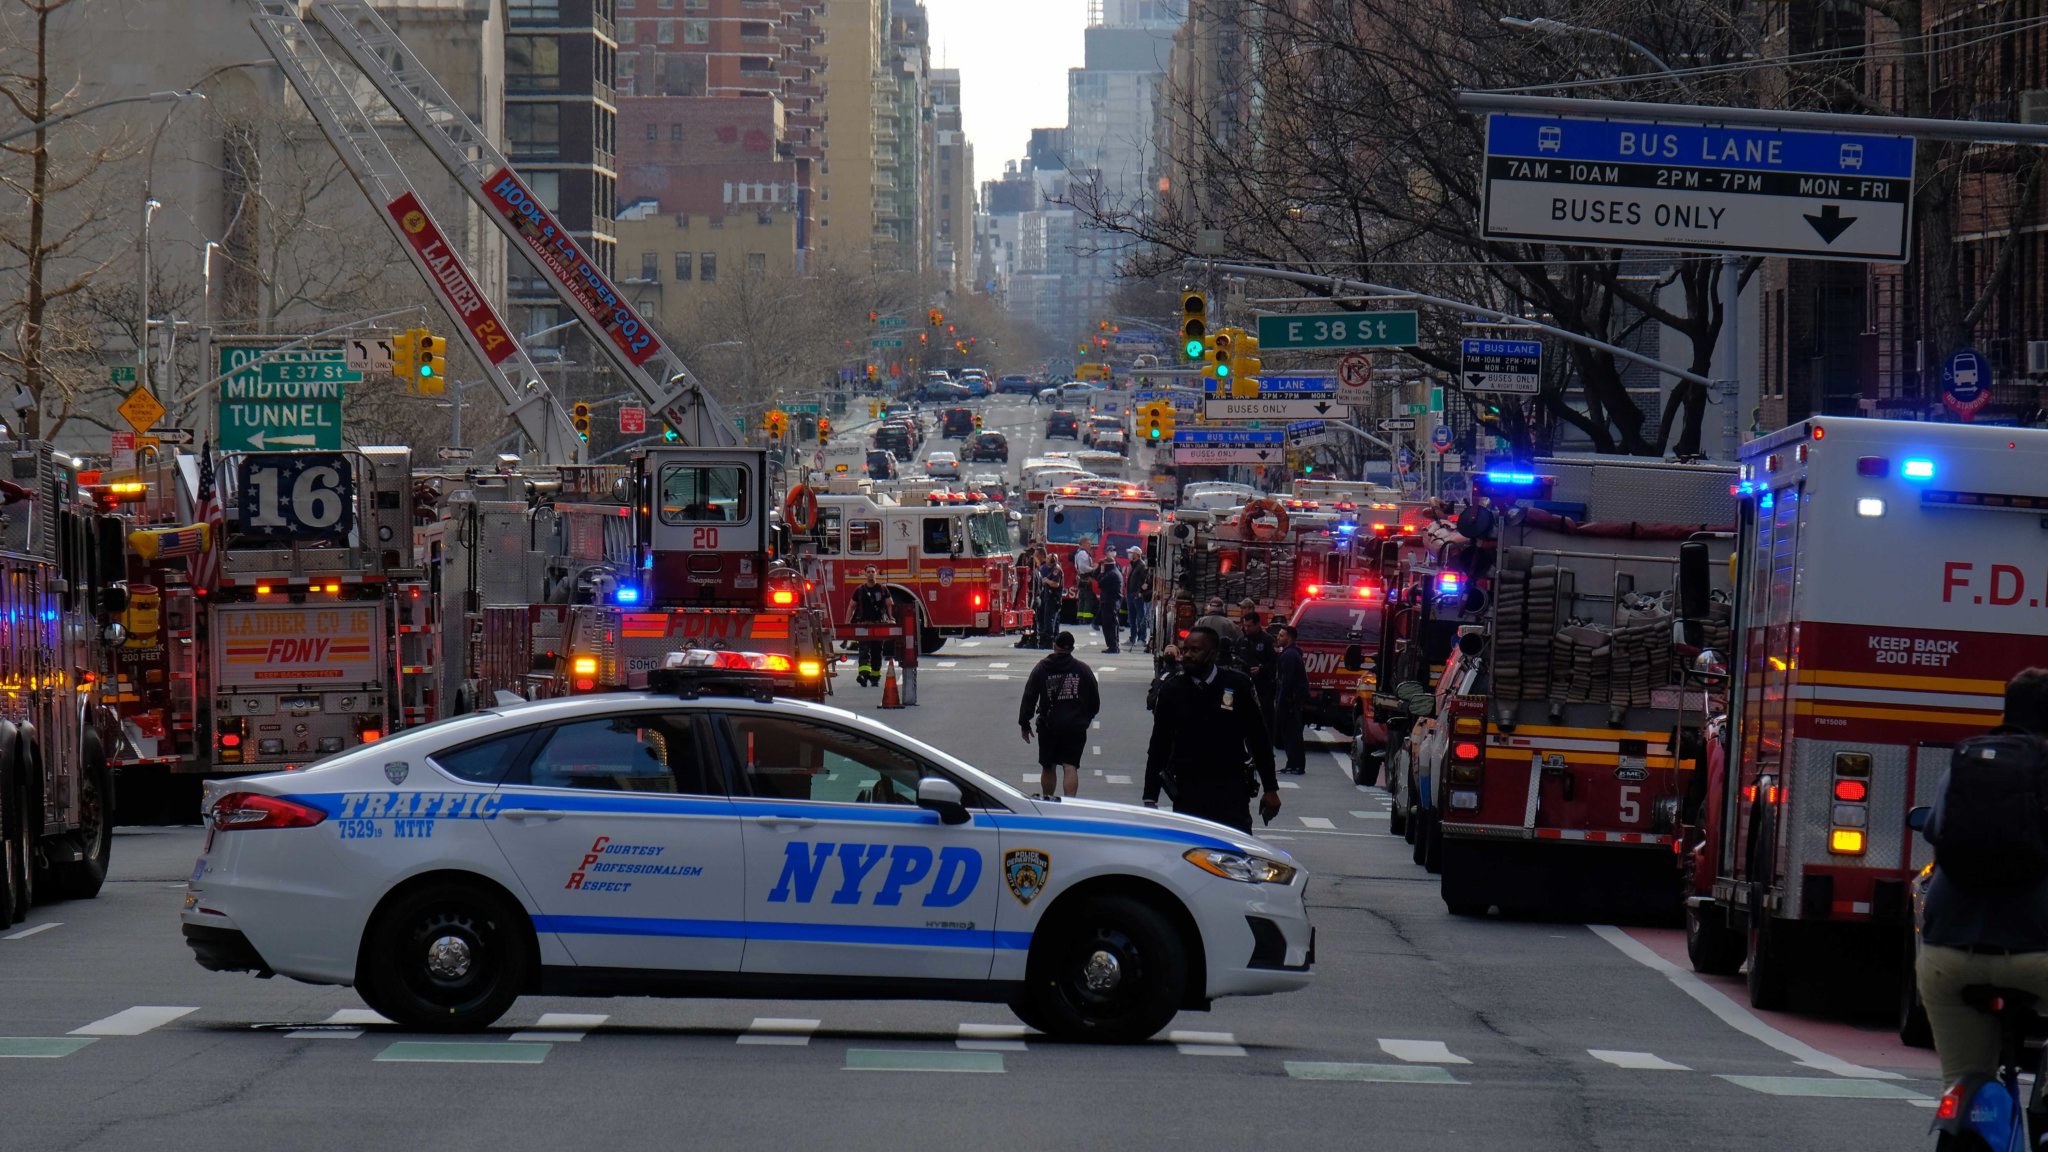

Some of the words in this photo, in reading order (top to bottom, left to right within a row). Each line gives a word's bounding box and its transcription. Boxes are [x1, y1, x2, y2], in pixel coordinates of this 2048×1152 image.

[1620, 132, 1678, 157] BUS
[1702, 137, 1783, 164] LANE
[1507, 161, 1548, 178] 7AM
[1569, 164, 1619, 182] 10AM
[1656, 170, 1699, 187] 2PM
[1720, 173, 1762, 191] 7PM
[1800, 177, 1840, 195] MON
[1860, 181, 1890, 198] FRI
[492, 176, 545, 226] HOOK
[543, 225, 555, 238] &
[1551, 198, 1641, 225] BUSES
[1654, 203, 1726, 230] ONLY
[525, 235, 568, 281] MIDTOWN
[565, 278, 597, 315] HI-RISE
[422, 239, 481, 317] LADDER
[475, 319, 506, 351] 24
[1289, 322, 1303, 341] E
[1314, 320, 1347, 341] 38
[1358, 320, 1387, 339] St
[1484, 344, 1505, 353] BUS
[1507, 345, 1535, 354] LANE
[280, 366, 289, 379] E
[296, 366, 317, 379] 37
[324, 365, 343, 378] St
[350, 361, 368, 369] ONLY
[375, 361, 393, 369] ONLY
[1278, 381, 1305, 390] LANE
[1488, 374, 1513, 382] BUSES
[1516, 375, 1536, 383] ONLY
[1227, 404, 1259, 413] BUSES
[1262, 404, 1287, 413] ONLY
[1946, 393, 1955, 404] NO
[1957, 391, 1989, 409] STANDING
[230, 404, 331, 427] TUNNEL
[250, 465, 342, 528] 16
[693, 527, 718, 549] 20
[1943, 561, 2048, 608] F.D.
[226, 612, 306, 635] LADDER
[351, 611, 369, 632] 16
[666, 614, 749, 638] FDNY
[1349, 608, 1366, 630] 7
[266, 638, 330, 663] FDNY
[1869, 636, 1911, 650] KEEP
[1914, 640, 1960, 653] BACK
[122, 653, 139, 661] 200
[140, 652, 160, 661] FEET
[629, 659, 658, 670] SOHO
[1876, 651, 1908, 664] 200
[1912, 653, 1950, 667] FEET
[340, 792, 502, 819] TRAFFIC
[1619, 785, 1641, 823] 5
[394, 820, 434, 838] MTTF
[592, 836, 664, 856] COURTESY
[578, 854, 703, 876] PROFESSIONALISM
[1007, 857, 1047, 868] DEPARTMENT
[565, 872, 631, 892] RESPECT
[767, 842, 983, 908] NYPD
[926, 921, 967, 929] HYBRID
